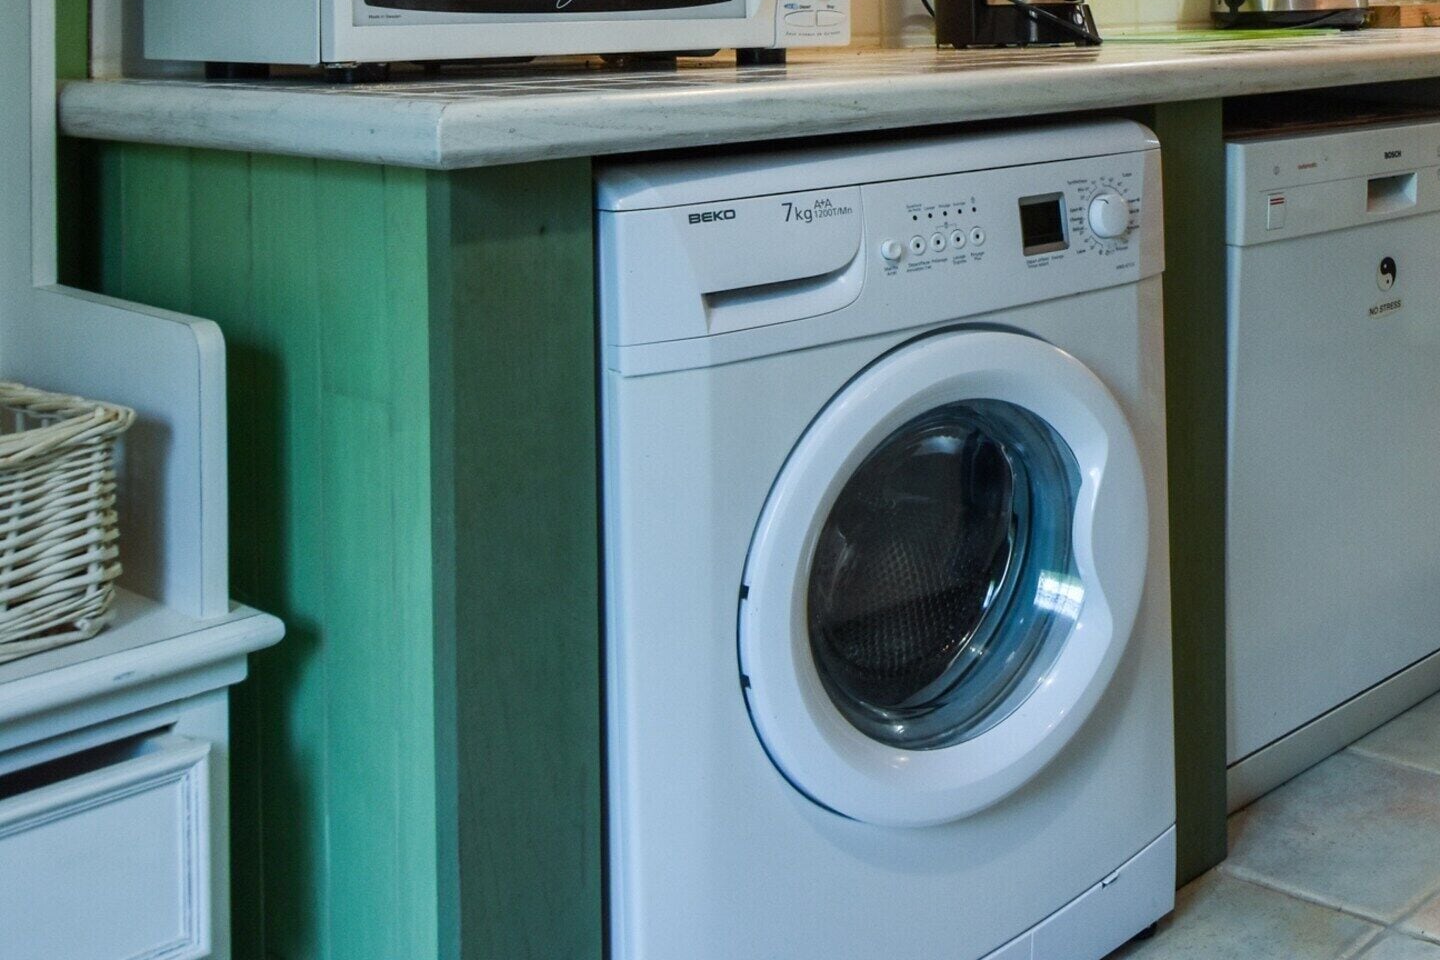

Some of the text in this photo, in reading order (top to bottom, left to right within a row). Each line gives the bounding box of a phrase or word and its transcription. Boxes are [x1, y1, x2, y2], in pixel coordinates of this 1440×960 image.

[1384, 150, 1402, 160] BOSCH
[688, 209, 736, 224] BEKO
[1368, 299, 1402, 315] NO STRESS
